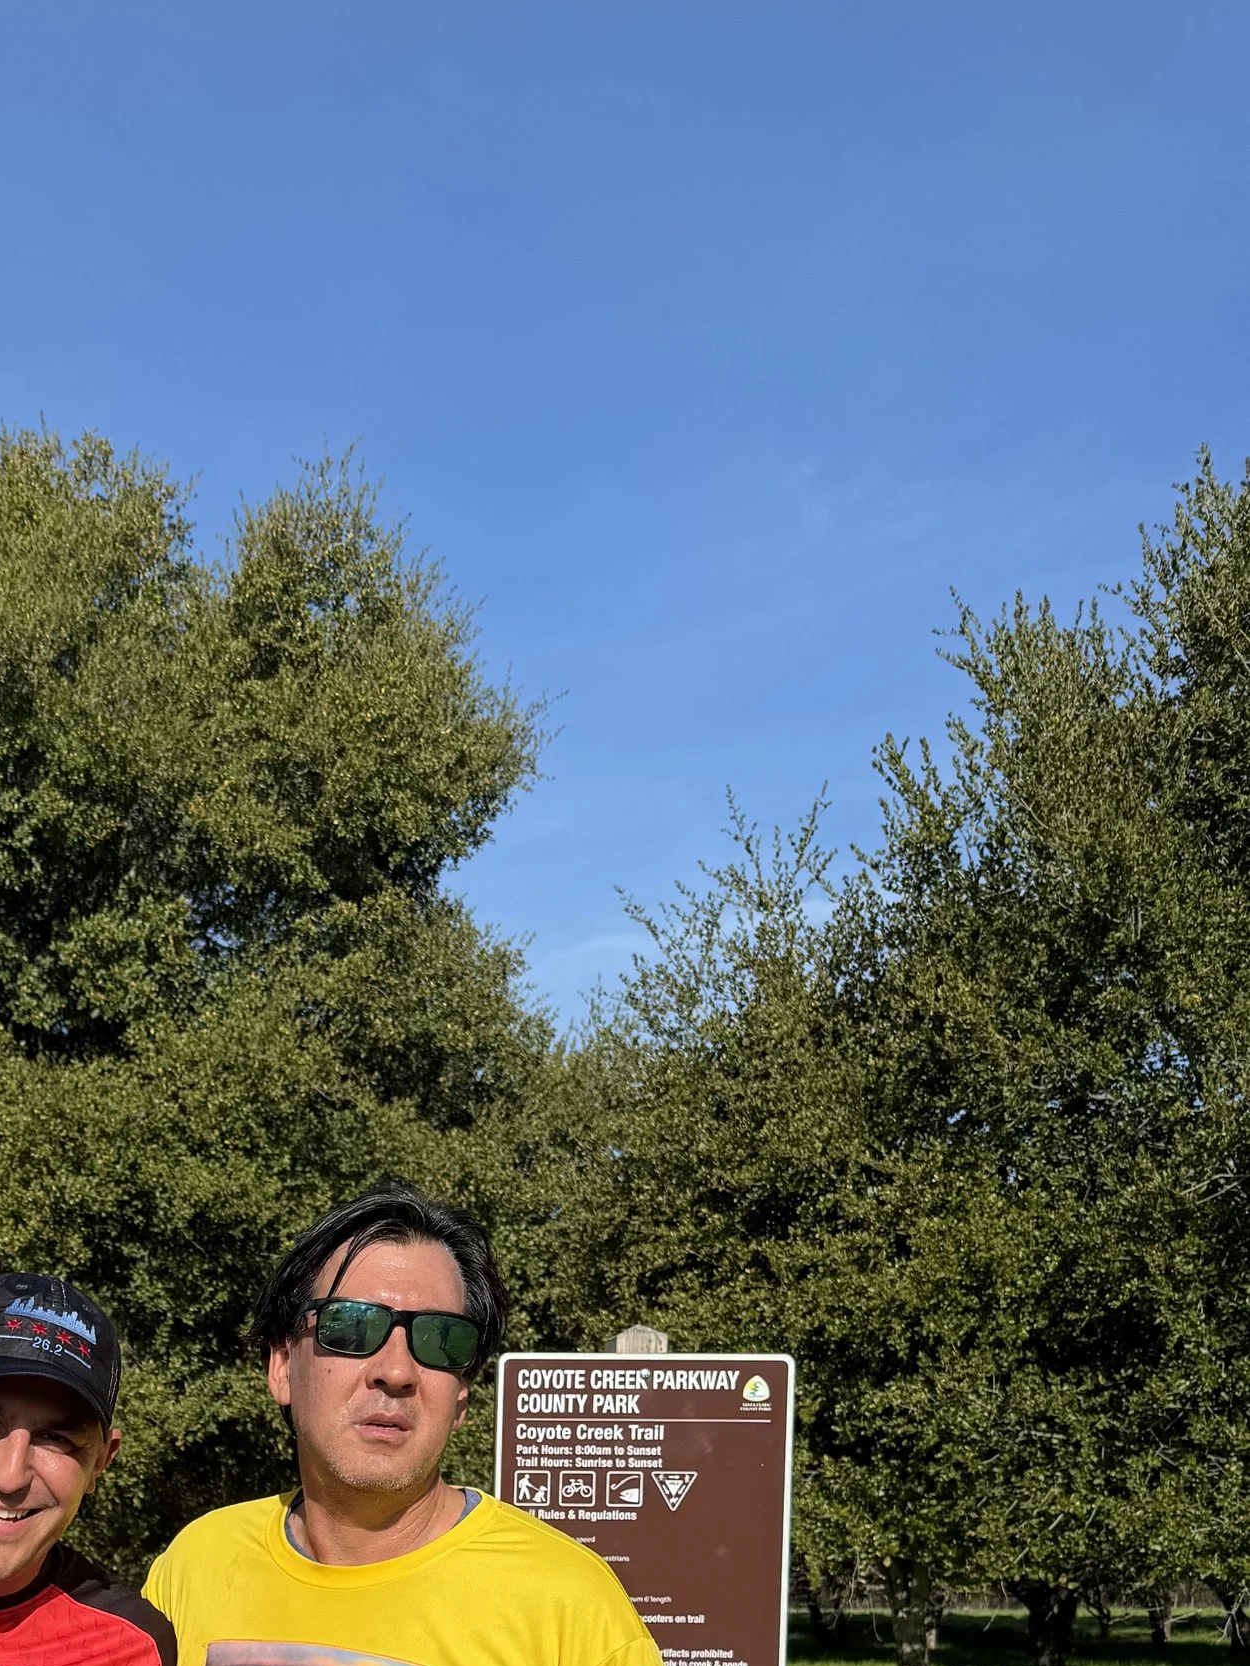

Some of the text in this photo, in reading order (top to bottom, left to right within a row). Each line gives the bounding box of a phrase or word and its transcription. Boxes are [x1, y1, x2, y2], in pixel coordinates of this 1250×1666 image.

[32, 1336, 63, 1357] 26.2
[517, 1369, 740, 1390] COYOTE CREEK PARKWAY
[516, 1393, 640, 1414] COUNTY PARK
[515, 1423, 665, 1442] Coyote Creek Trail
[516, 1444, 662, 1456] Park Hours: 8:00am to Sunset
[515, 1456, 663, 1468] Trail Hours: Sunrise to Sunset
[538, 1510, 566, 1520] Rules
[567, 1510, 576, 1519] &
[578, 1510, 637, 1522] Regulations
[651, 1596, 672, 1604] length
[687, 1615, 705, 1623] trail
[660, 1648, 734, 1659] rtifacts prohibited
